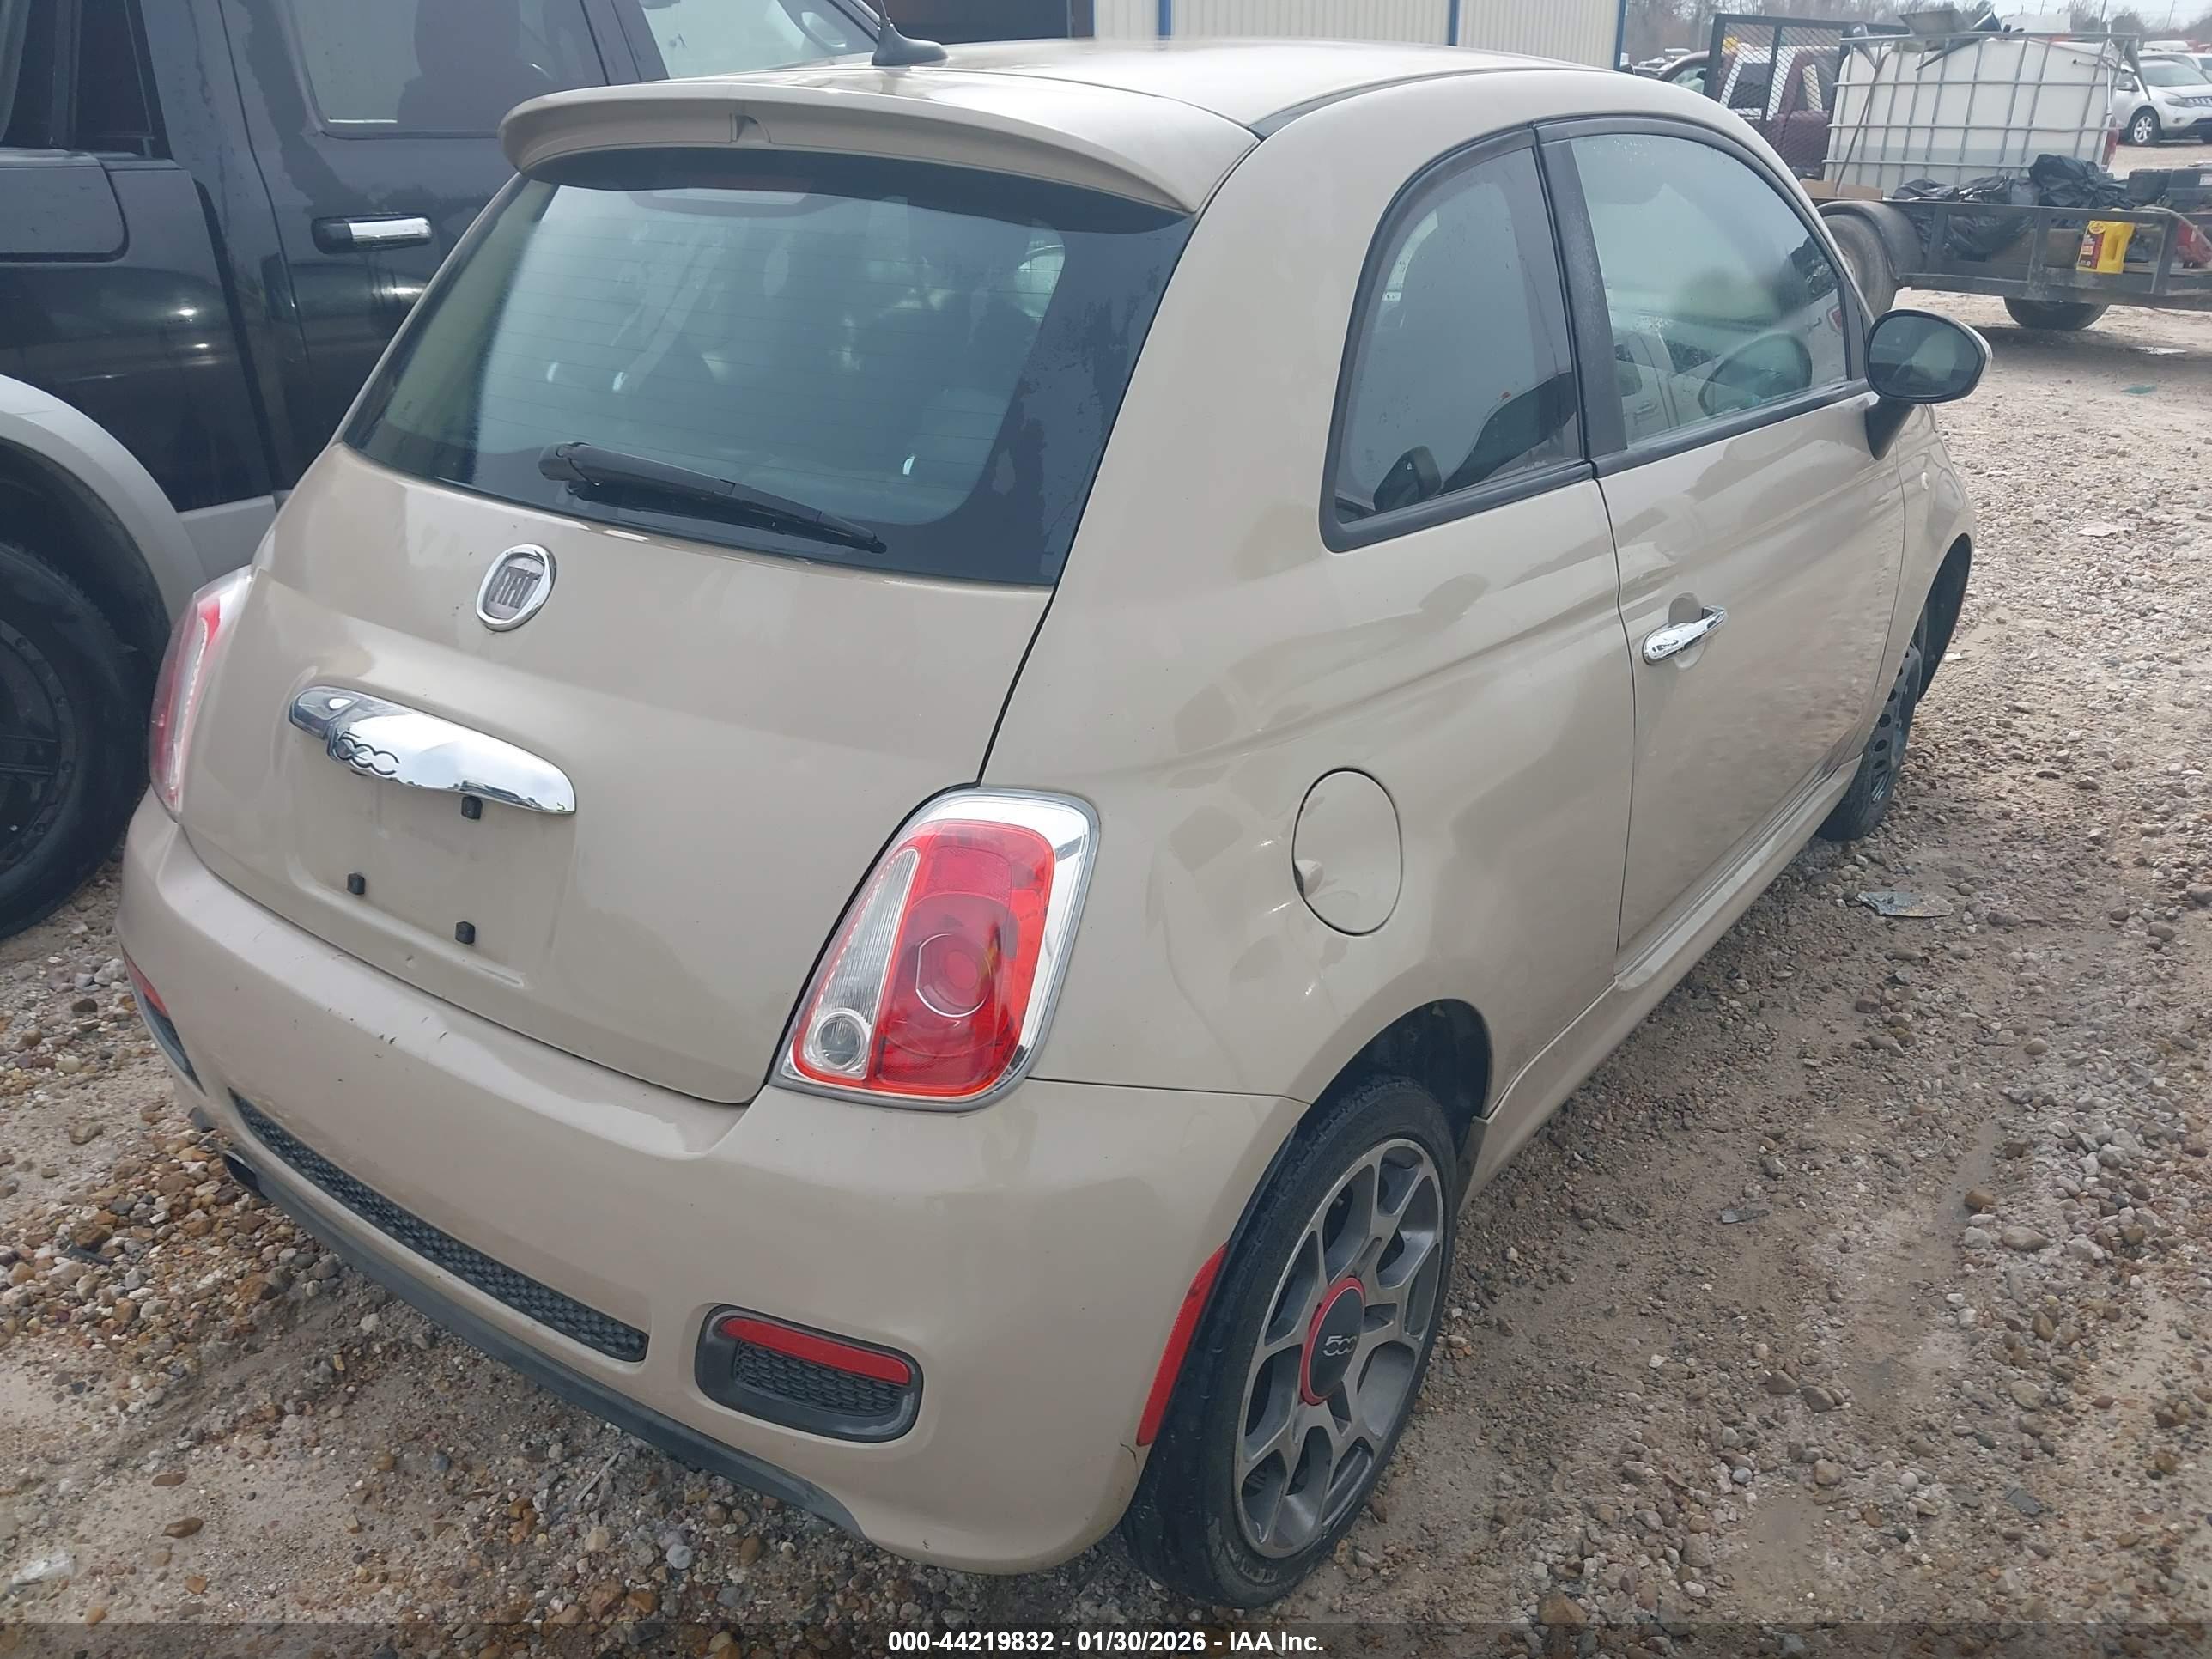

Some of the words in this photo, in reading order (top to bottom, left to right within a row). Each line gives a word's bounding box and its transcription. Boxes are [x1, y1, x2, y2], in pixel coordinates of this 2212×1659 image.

[490, 565, 543, 609] FIAT
[335, 731, 401, 776] 500
[1322, 1334, 1358, 1357] 500
